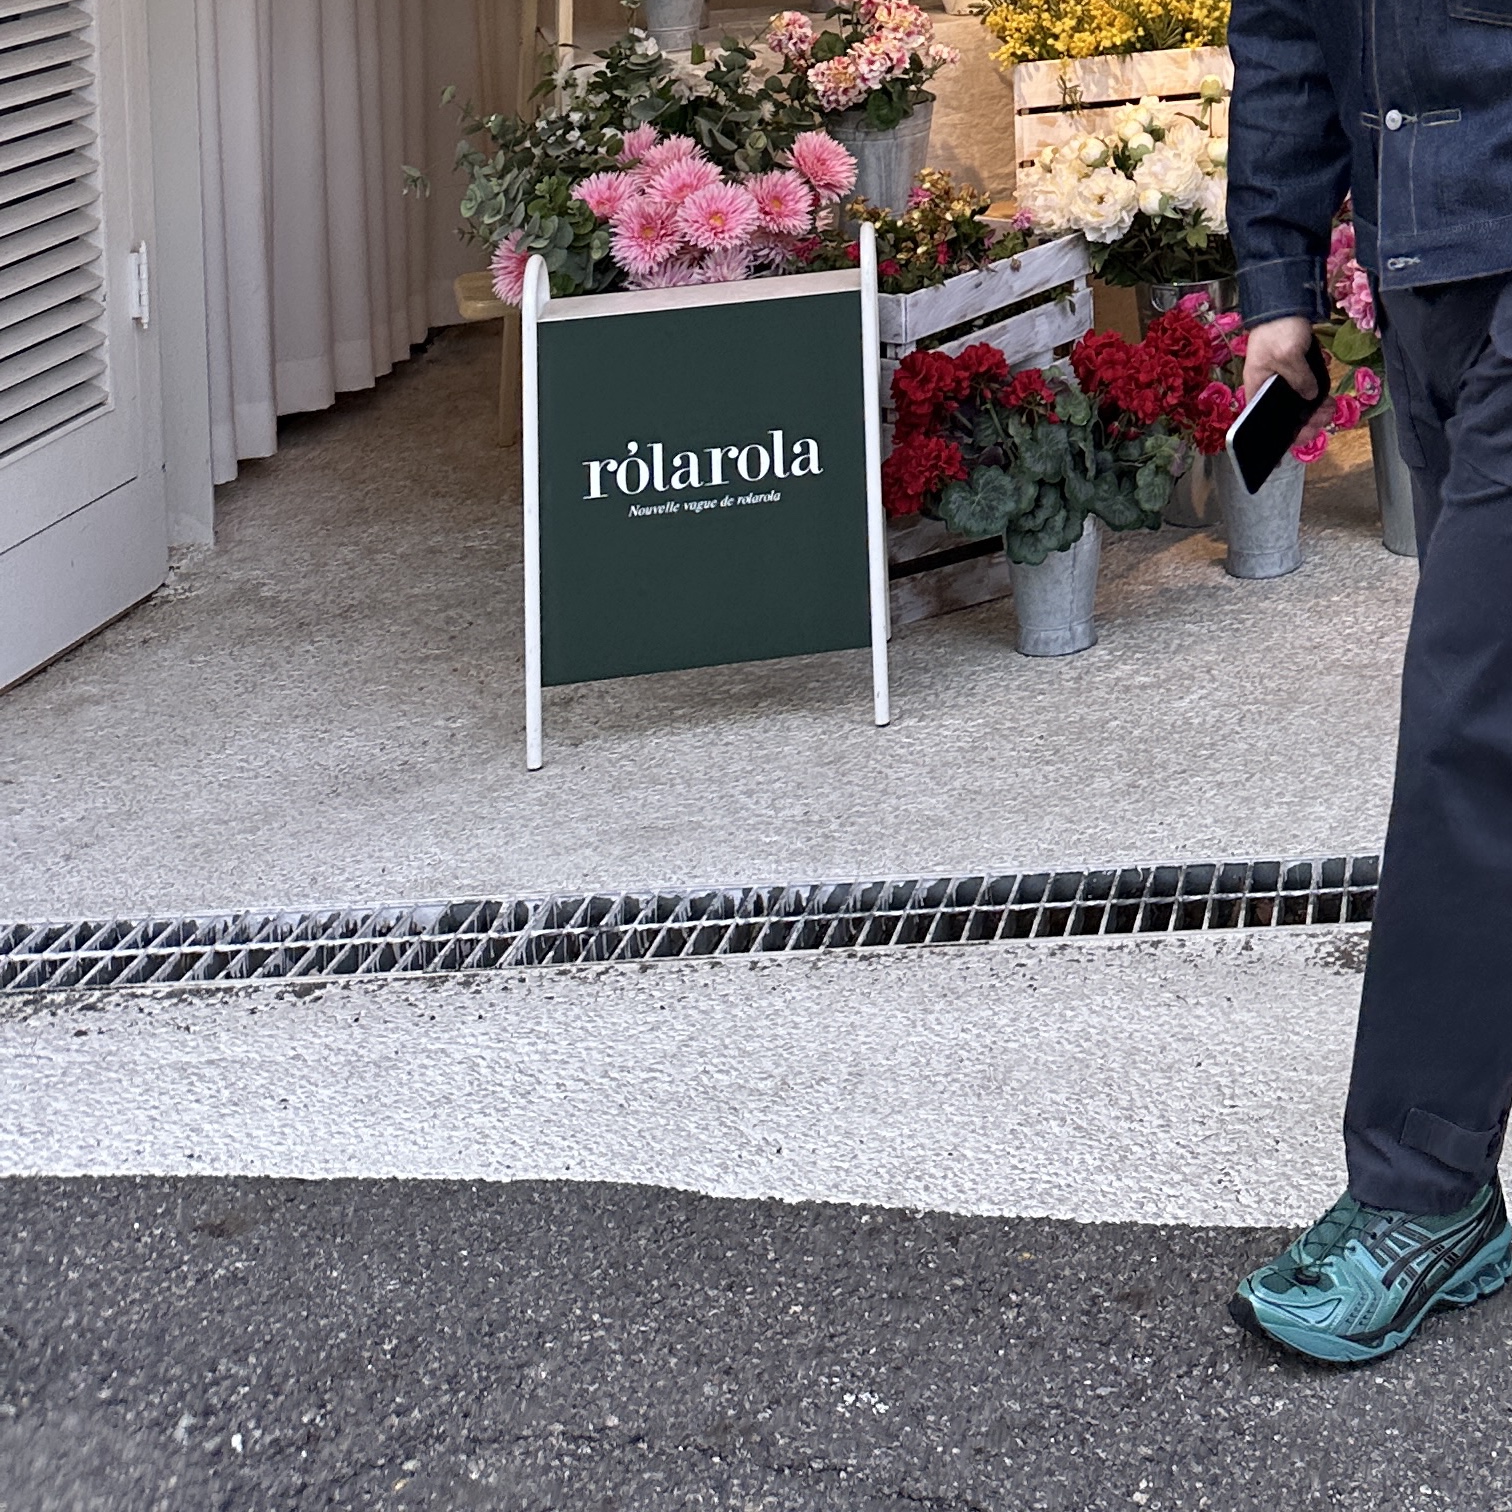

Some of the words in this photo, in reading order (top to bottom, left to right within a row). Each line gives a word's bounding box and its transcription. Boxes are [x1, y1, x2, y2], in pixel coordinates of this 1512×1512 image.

[628, 500, 680, 518] Nouvelle
[683, 498, 718, 514] vague
[719, 494, 735, 508] de
[736, 489, 781, 506] rolarola
